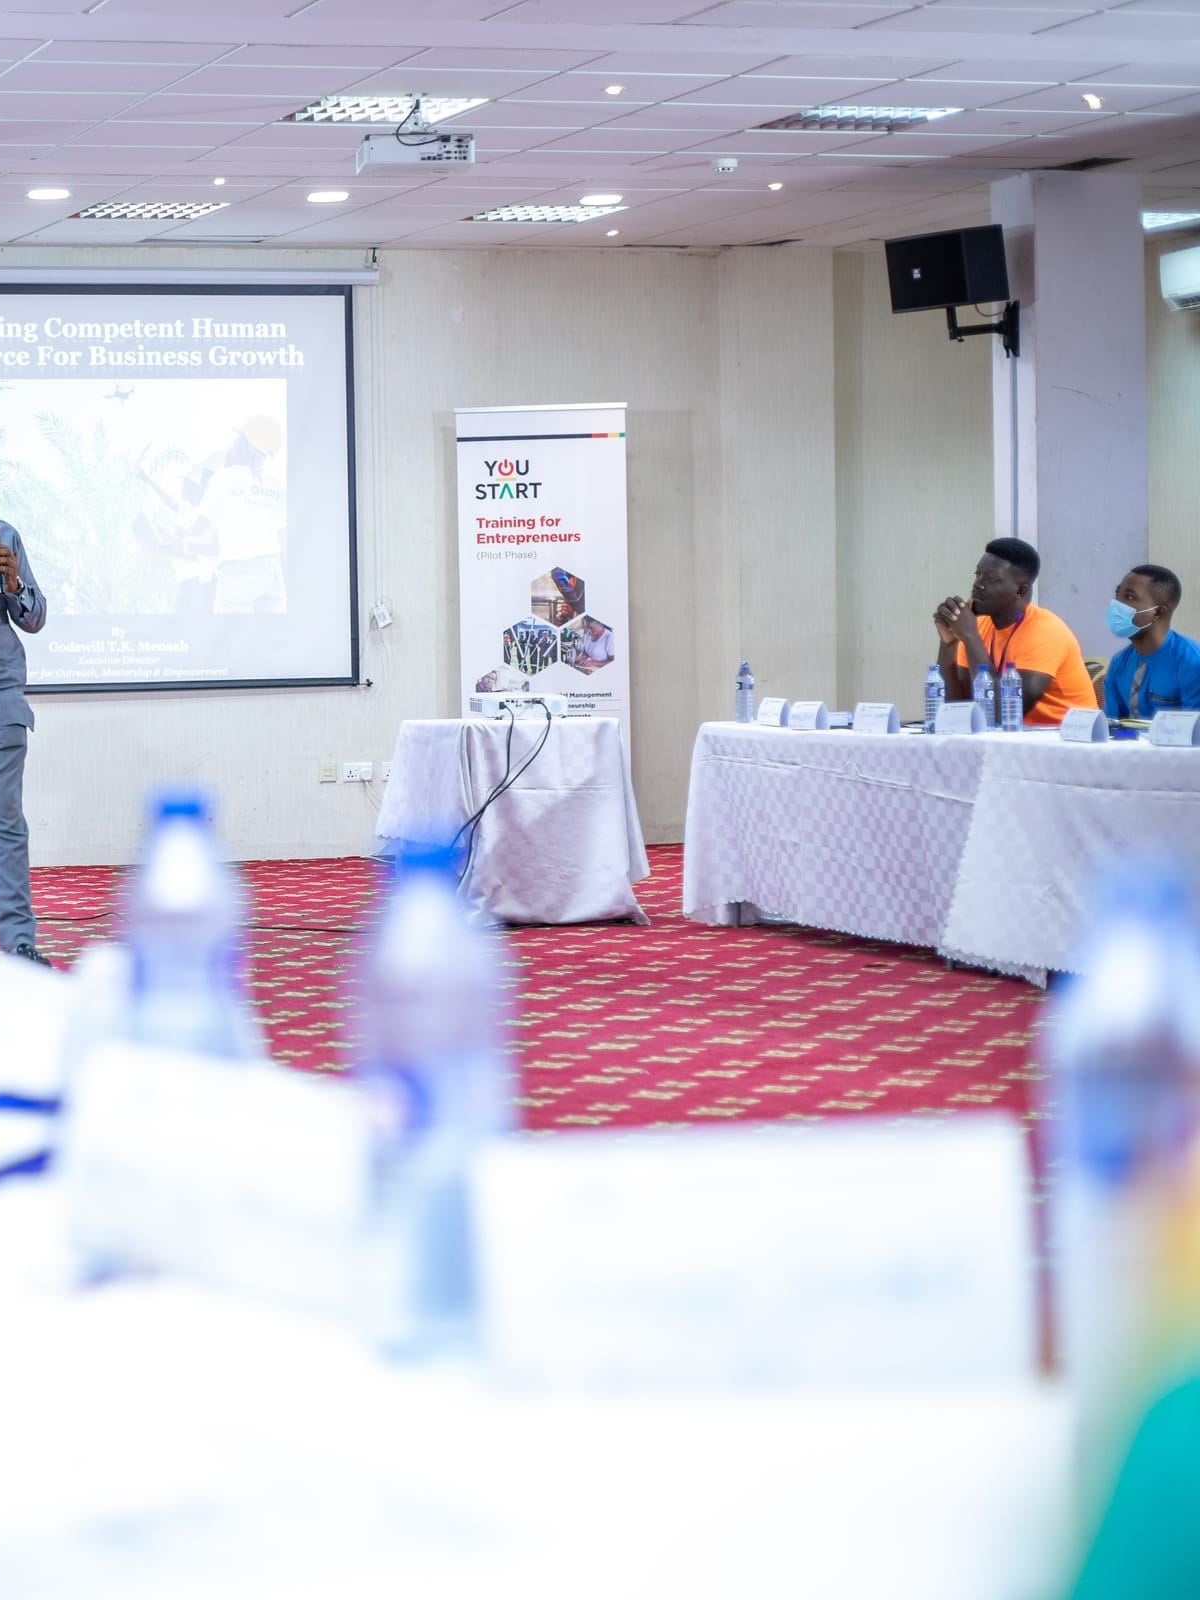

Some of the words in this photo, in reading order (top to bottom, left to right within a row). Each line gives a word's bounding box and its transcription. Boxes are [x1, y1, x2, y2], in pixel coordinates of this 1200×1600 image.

[43, 317, 185, 343] Competent
[192, 317, 287, 339] Human
[36, 345, 82, 367] For
[88, 345, 202, 367] Business
[208, 344, 305, 367] Growth
[484, 458, 530, 477] YOU
[475, 482, 542, 500] START
[475, 516, 536, 530] Training
[540, 515, 561, 527] for
[476, 532, 581, 545] Entrepreneurs
[476, 551, 502, 560] (Pilot
[505, 550, 538, 560] Phase)
[111, 626, 127, 639] By
[48, 640, 104, 653] Godswill
